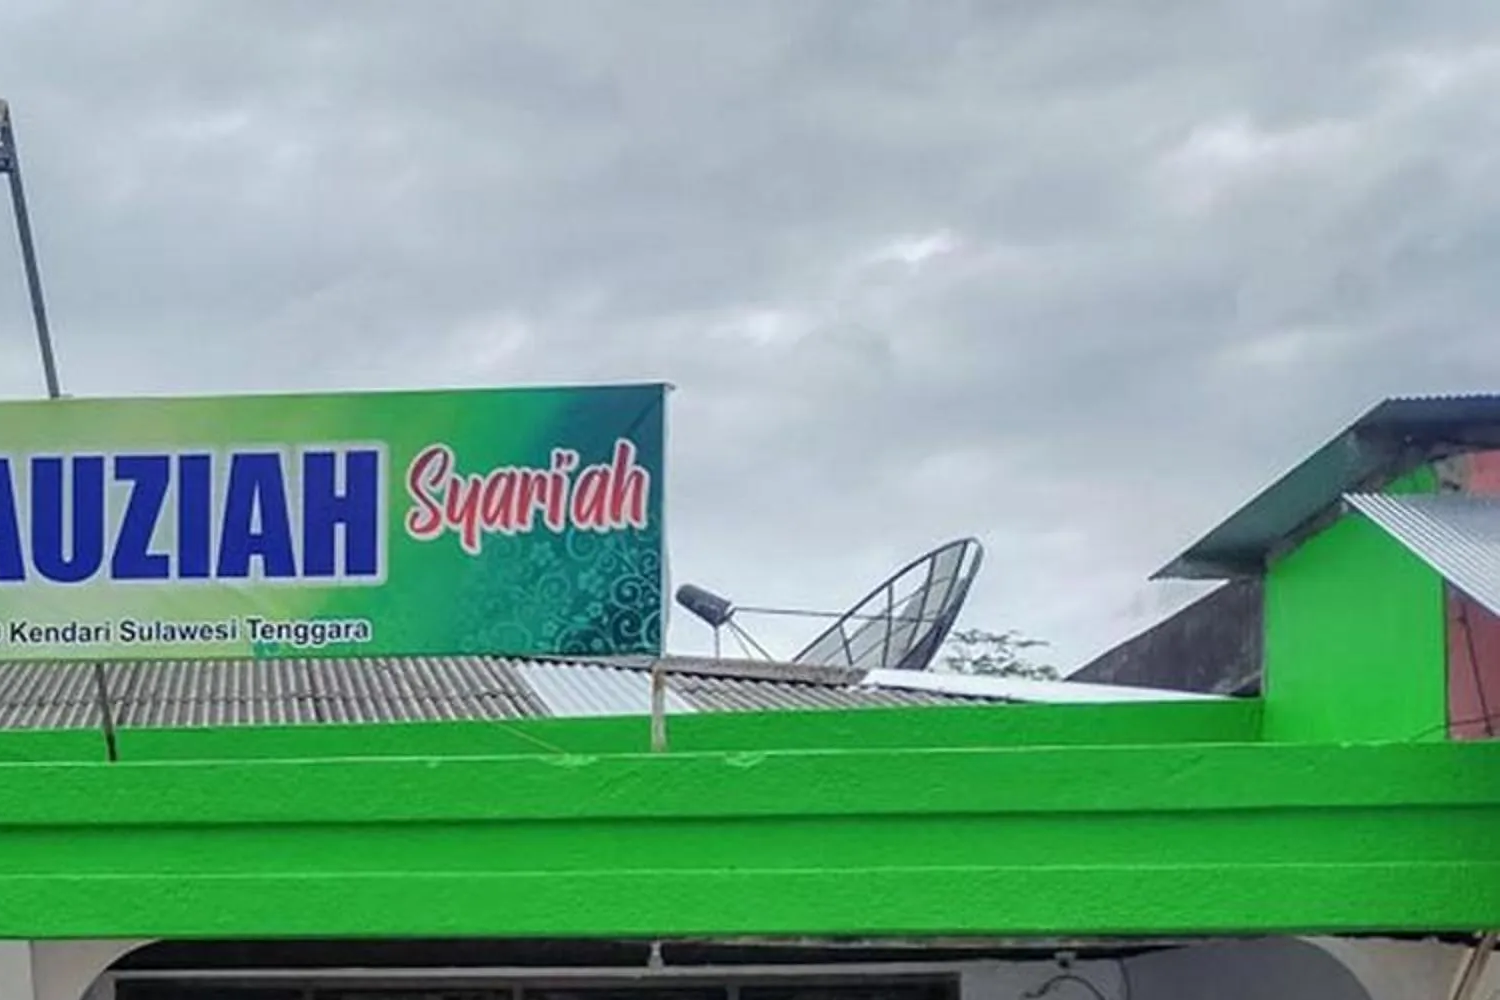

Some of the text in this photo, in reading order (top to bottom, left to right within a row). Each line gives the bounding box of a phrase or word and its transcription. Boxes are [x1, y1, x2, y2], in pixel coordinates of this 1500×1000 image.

[9, 620, 112, 644] Kendari
[119, 619, 238, 642] Sulawesi
[246, 618, 369, 645] Tenggara
